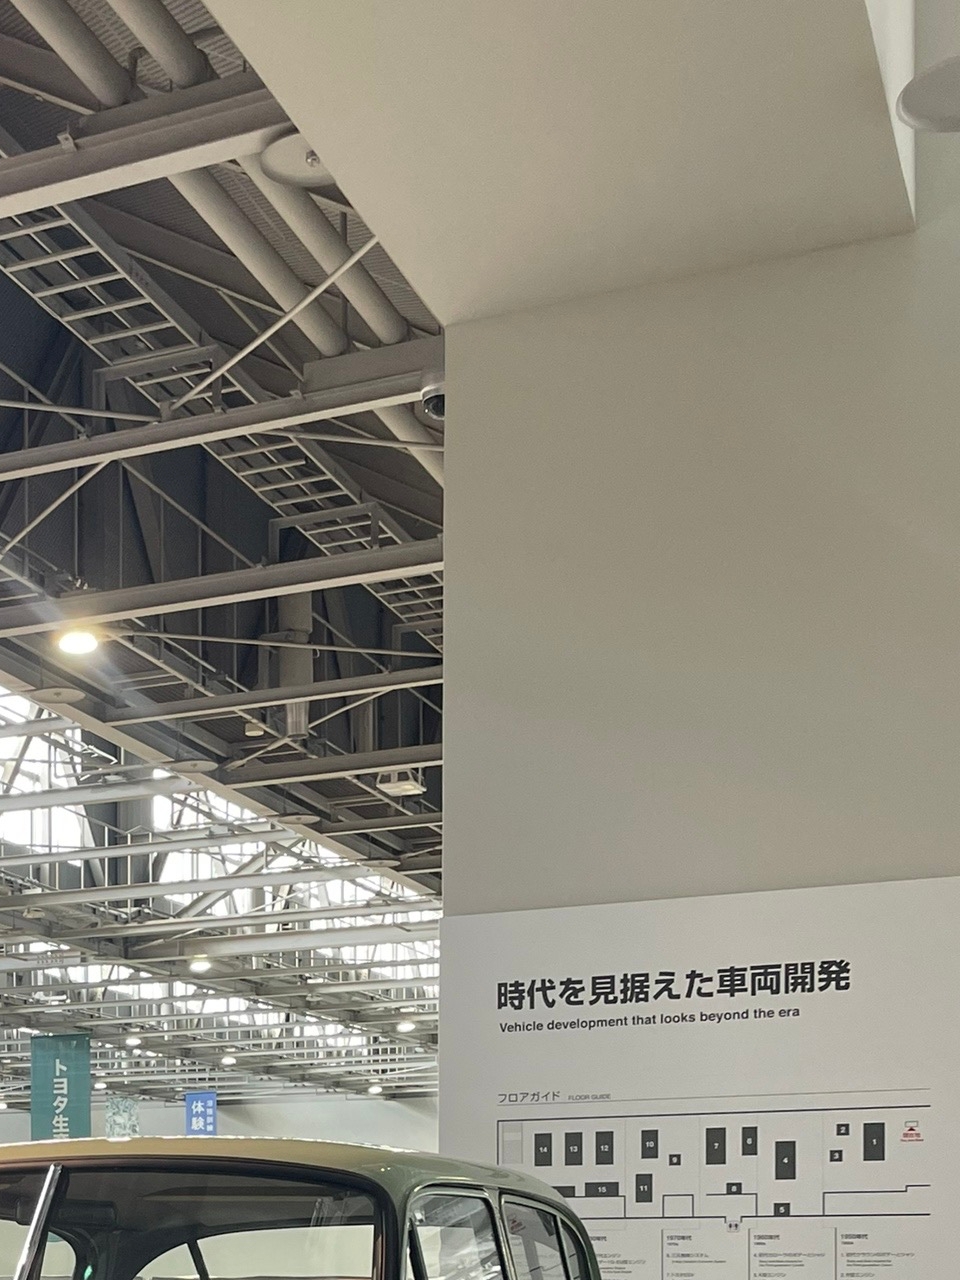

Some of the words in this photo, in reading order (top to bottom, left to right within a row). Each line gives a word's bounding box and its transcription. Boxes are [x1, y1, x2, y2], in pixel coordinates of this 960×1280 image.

[497, 959, 851, 1010] 時代を見据えた車両開発
[499, 1021, 544, 1033] Vehicle
[547, 1016, 628, 1030] development
[632, 1014, 657, 1025] that
[660, 1012, 696, 1024] looks
[700, 1009, 749, 1023] beyond
[753, 1008, 775, 1018] the
[778, 1008, 800, 1018] era
[497, 1091, 561, 1103] フロアガイド
[191, 1100, 205, 1131] 体験
